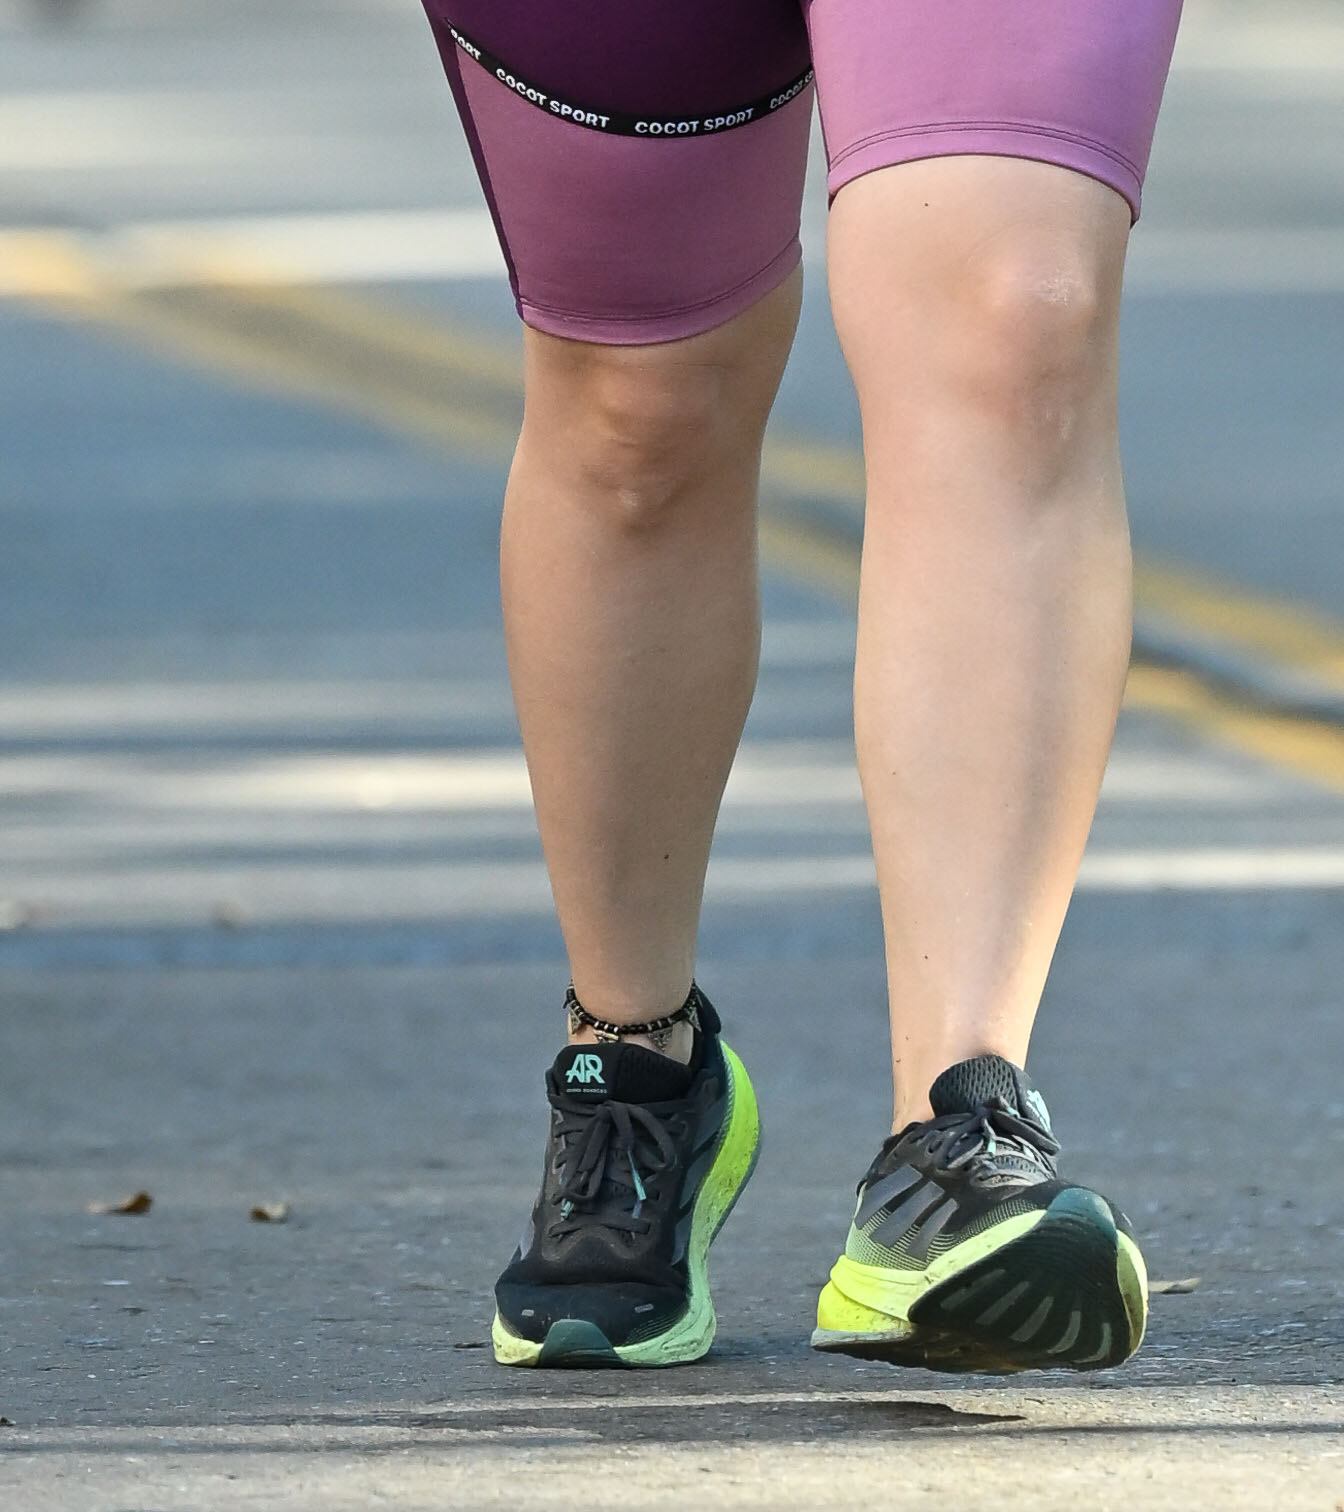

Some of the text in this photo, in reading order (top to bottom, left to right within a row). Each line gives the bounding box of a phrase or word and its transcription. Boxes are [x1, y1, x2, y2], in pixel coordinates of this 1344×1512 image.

[495, 68, 548, 106] COCOT
[549, 100, 611, 128] SPORT
[635, 121, 700, 134] COCOT
[703, 107, 755, 131] SPORT
